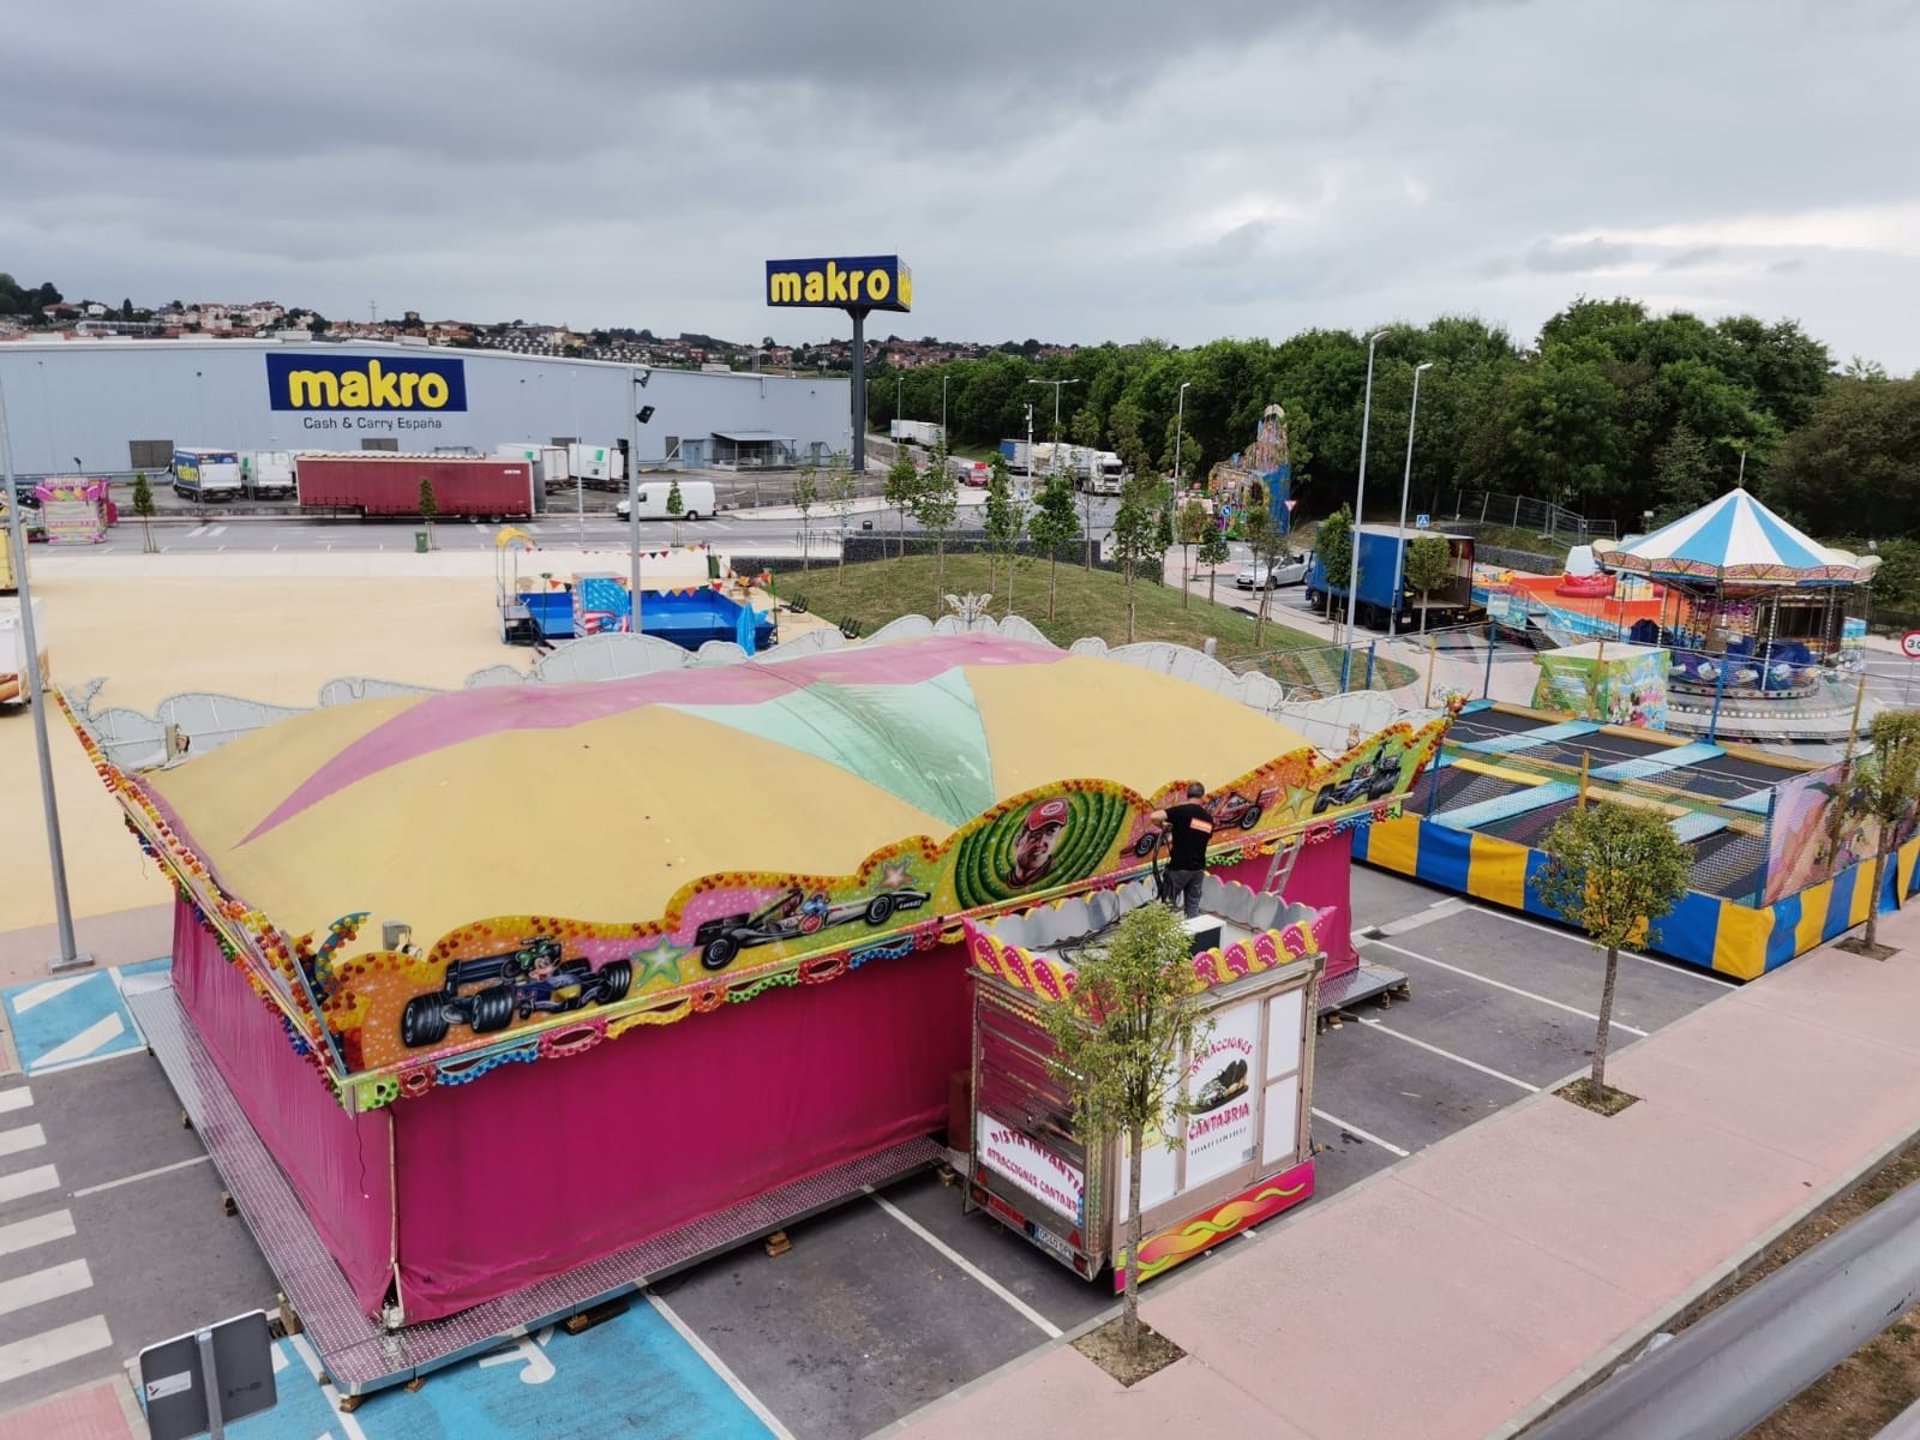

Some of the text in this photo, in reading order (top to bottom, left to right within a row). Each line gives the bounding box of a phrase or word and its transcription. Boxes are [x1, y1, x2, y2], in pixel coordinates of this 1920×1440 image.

[771, 261, 890, 302] makro
[288, 359, 449, 408] makro
[303, 417, 442, 431] Cash & Carry España
[1191, 1037, 1252, 1075] ATACCIONES
[1188, 1102, 1250, 1140] CANTABRIA
[1039, 1181, 1077, 1212] CANTABR
